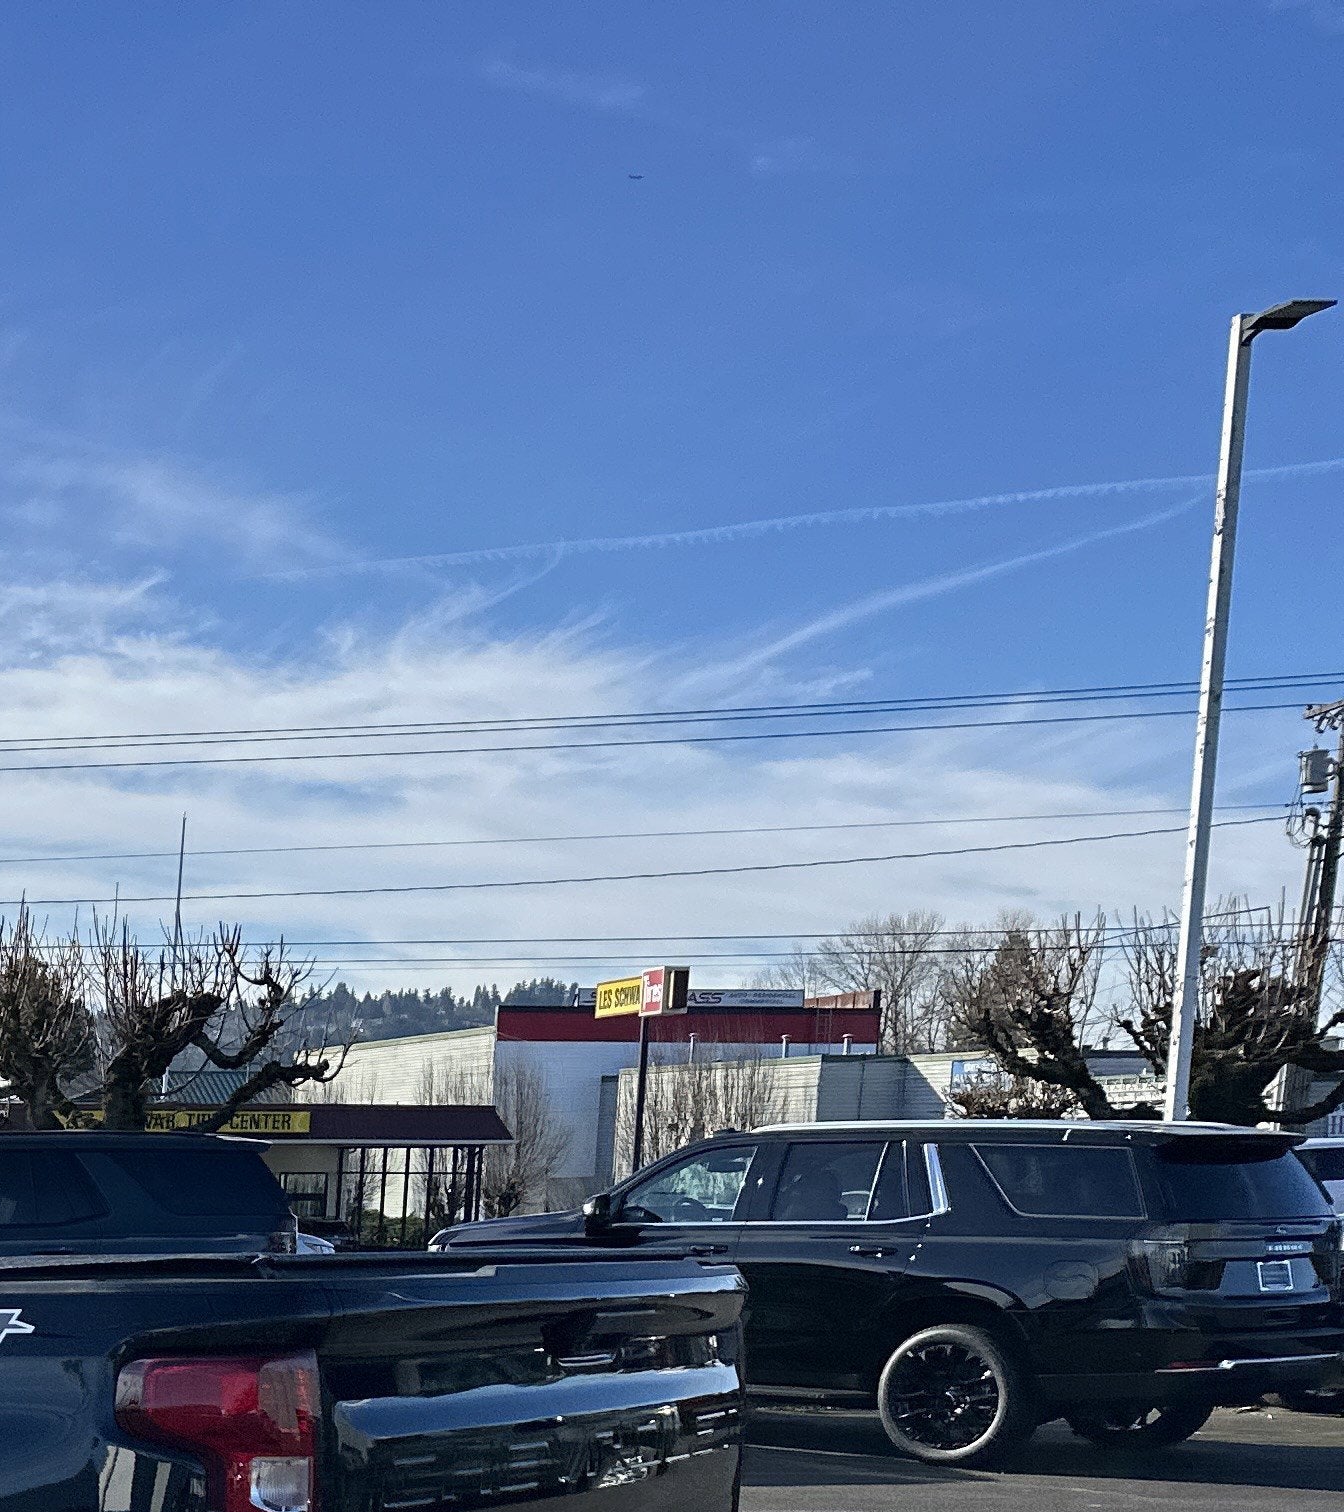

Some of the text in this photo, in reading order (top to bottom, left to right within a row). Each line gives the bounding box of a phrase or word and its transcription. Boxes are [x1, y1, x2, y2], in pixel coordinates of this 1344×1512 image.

[599, 988, 612, 1010] LES
[614, 985, 641, 1007] SCHWA
[229, 1113, 292, 1130] CENTER
